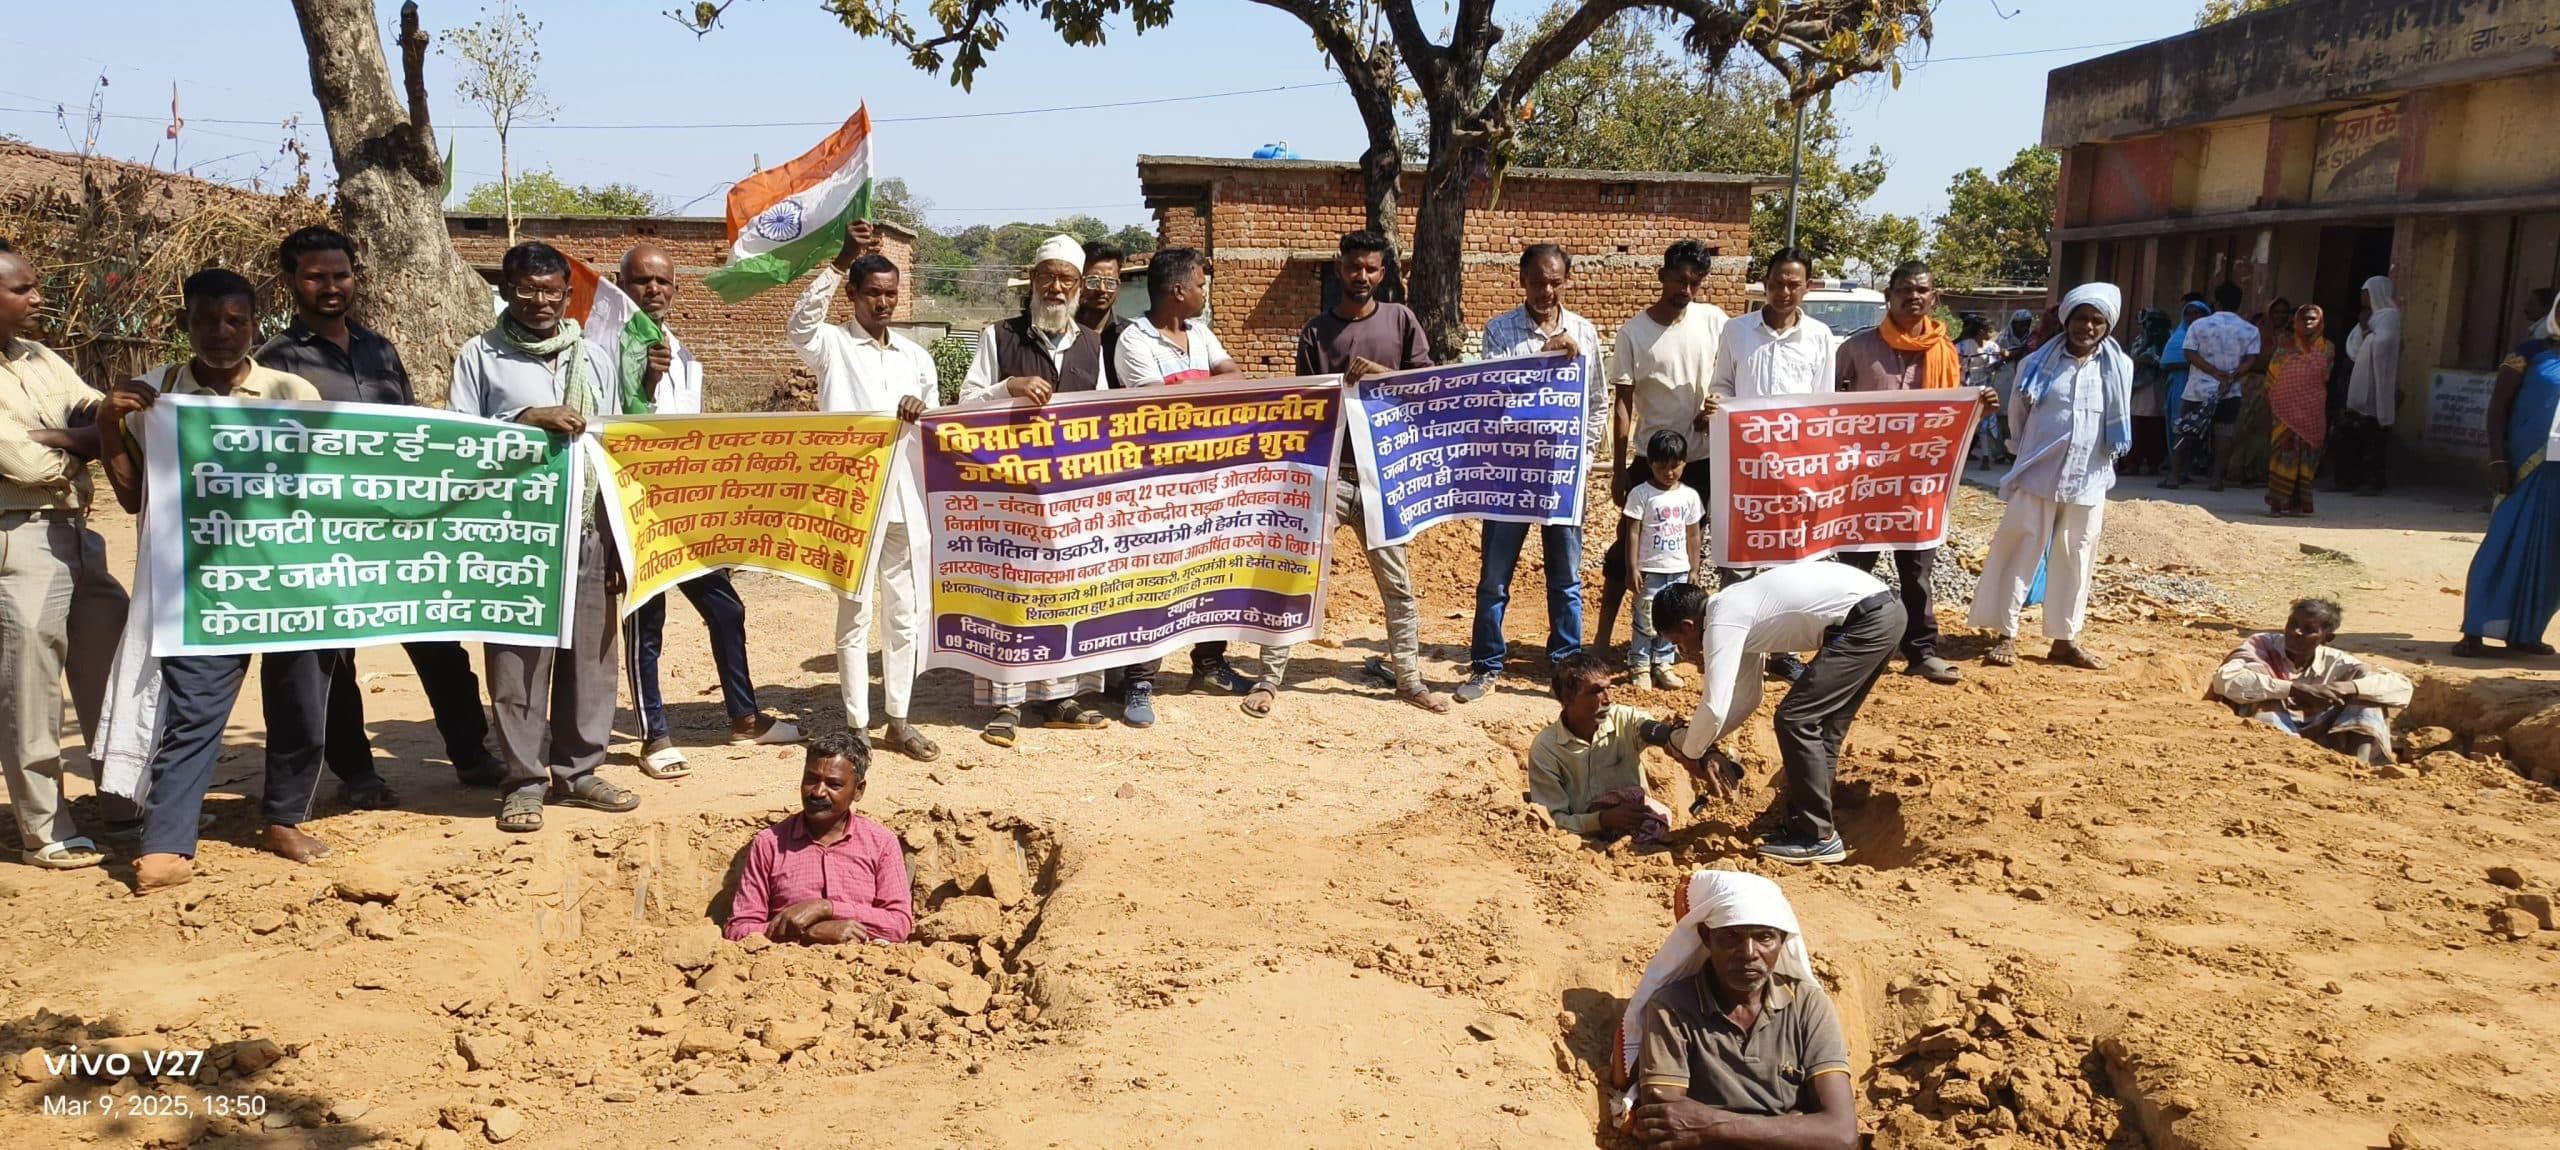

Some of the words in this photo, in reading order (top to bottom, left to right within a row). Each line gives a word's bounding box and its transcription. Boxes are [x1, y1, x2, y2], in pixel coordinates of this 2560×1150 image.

[1369, 376, 1443, 401] पंचायती
[1444, 372, 1481, 390] राज
[1482, 367, 1553, 385] व्यवस्था
[1555, 362, 1581, 383] को
[935, 413, 1057, 454] किसानों
[1058, 416, 1102, 443] का
[1108, 394, 1329, 438] अनिश्चितकालीन
[1371, 401, 1426, 428] मजबूत
[1428, 395, 1463, 412] कर
[1463, 389, 1538, 409] लातेहार
[1740, 412, 1803, 445] टोरी
[1805, 407, 1919, 438] जंक्शन
[1922, 406, 1961, 430] के
[210, 418, 389, 456] लातेहार
[608, 430, 704, 454] सीएनटी
[708, 431, 760, 450] एक्ट
[761, 431, 797, 446] का
[799, 425, 889, 448] उल्लंघन
[1377, 435, 1393, 457] के
[1392, 423, 1420, 451] सभी
[1421, 418, 1481, 440] पंचायत
[1483, 415, 1569, 436] सचिवालय
[1568, 416, 1581, 436] से
[1446, 442, 1499, 462] प्रमाण
[1501, 442, 1531, 459] पत्र
[615, 462, 642, 489] कर
[642, 455, 712, 476] जमीन
[711, 452, 745, 473] की
[745, 451, 802, 474] बिक्री,
[809, 451, 880, 485] रजिस्ट्री
[955, 454, 1052, 485] जमीन
[1056, 440, 1147, 481] समाधि
[1149, 433, 1254, 466] सत्याग्रह
[1405, 473, 1433, 496] साथ
[1434, 465, 1453, 486] ही
[1454, 461, 1518, 483] मनरेगा
[1520, 468, 1547, 485] का
[1547, 465, 1577, 486] कार्य
[1737, 451, 1830, 480] पश्चिम
[1833, 442, 1862, 472] में
[1909, 435, 1953, 467] पड़े
[191, 462, 345, 500] निबंधन
[350, 468, 517, 502] कार्यालय
[522, 472, 560, 505] में
[646, 483, 718, 509] केवाला
[720, 478, 778, 500] किया
[779, 482, 810, 500] जा
[812, 484, 848, 508] रहा
[850, 486, 870, 514] है
[944, 494, 980, 513] टोरी
[998, 495, 1046, 517] चंदवा
[1048, 496, 1094, 516] एनएच
[1096, 490, 1112, 507] 99
[1138, 485, 1153, 501] 22
[1155, 484, 1179, 498] पर
[1222, 465, 1289, 490] ओवरब्रिज
[1290, 467, 1313, 487] का
[1433, 487, 1516, 510] सचिवालय
[1517, 489, 1537, 509] से
[1732, 483, 1850, 524] फुटओवर
[1851, 473, 1905, 503] ब्रिज
[1908, 472, 1949, 496] का
[189, 509, 316, 548] सीएनटी
[320, 517, 390, 545] एक्ट
[391, 517, 438, 541] का
[441, 510, 560, 547] उल्लंघन
[645, 514, 699, 544] केवाला
[700, 511, 729, 529] का
[729, 504, 786, 528] अंचल
[786, 511, 867, 548] कार्यालय
[944, 514, 1000, 533] निर्माण
[1002, 520, 1042, 543] चालू
[1040, 517, 1083, 540] कराने
[1084, 512, 1106, 531] की
[1107, 509, 1137, 529] ओर
[1226, 490, 1281, 507] परिवहन
[1282, 488, 1313, 510] मंत्री
[947, 535, 974, 553] श्री
[977, 535, 1041, 561] नितिन
[1113, 523, 1192, 553] मुख्यमंत्री
[1193, 517, 1214, 536] श्री
[1214, 510, 1254, 531] हेमंत
[1255, 509, 1309, 534] सोरेन,
[1745, 517, 1808, 551] कार्य
[1812, 513, 1865, 542] चालू
[199, 564, 275, 592] कर
[277, 552, 391, 589] जमीन
[395, 550, 451, 584] की
[456, 551, 549, 588] बिक्री
[639, 545, 685, 582] दाखिल
[686, 532, 747, 561] खारिज
[748, 533, 774, 557] भी
[776, 538, 798, 562] हो
[800, 544, 831, 571] रही
[938, 560, 1002, 579] झारखण्ड
[1002, 563, 1076, 585] विधानसभा
[1077, 562, 1107, 579] बजट
[1107, 557, 1130, 573] सत्र
[1131, 555, 1151, 570] का
[1153, 549, 1184, 565] ध्यान
[1231, 531, 1267, 550] करने
[1267, 532, 1283, 550] के
[941, 580, 1005, 602] शिलान्यास
[1006, 593, 1031, 605] कर
[1031, 592, 1059, 609] भूल
[1059, 588, 1080, 603] गये
[1082, 582, 1098, 598] श्री
[1099, 578, 1134, 595] नितिन
[1228, 556, 1243, 568] श्री
[1245, 554, 1275, 569] हेमंत
[200, 601, 327, 636] केवाला
[332, 599, 420, 629] करना
[425, 589, 476, 624] बंद
[480, 594, 546, 627] करो
[1167, 597, 1198, 618] स्थान
[945, 634, 963, 647] 09
[965, 639, 997, 658] मार्च
[997, 647, 1030, 663] 2025
[1033, 645, 1051, 661] से
[960, 616, 1013, 643] दिनांक
[1078, 631, 1128, 652] कामता
[1130, 621, 1175, 646] पंचायत
[1175, 610, 1240, 632] सचिवालय
[1243, 607, 1261, 623] के
[1263, 611, 1304, 629] समीप
